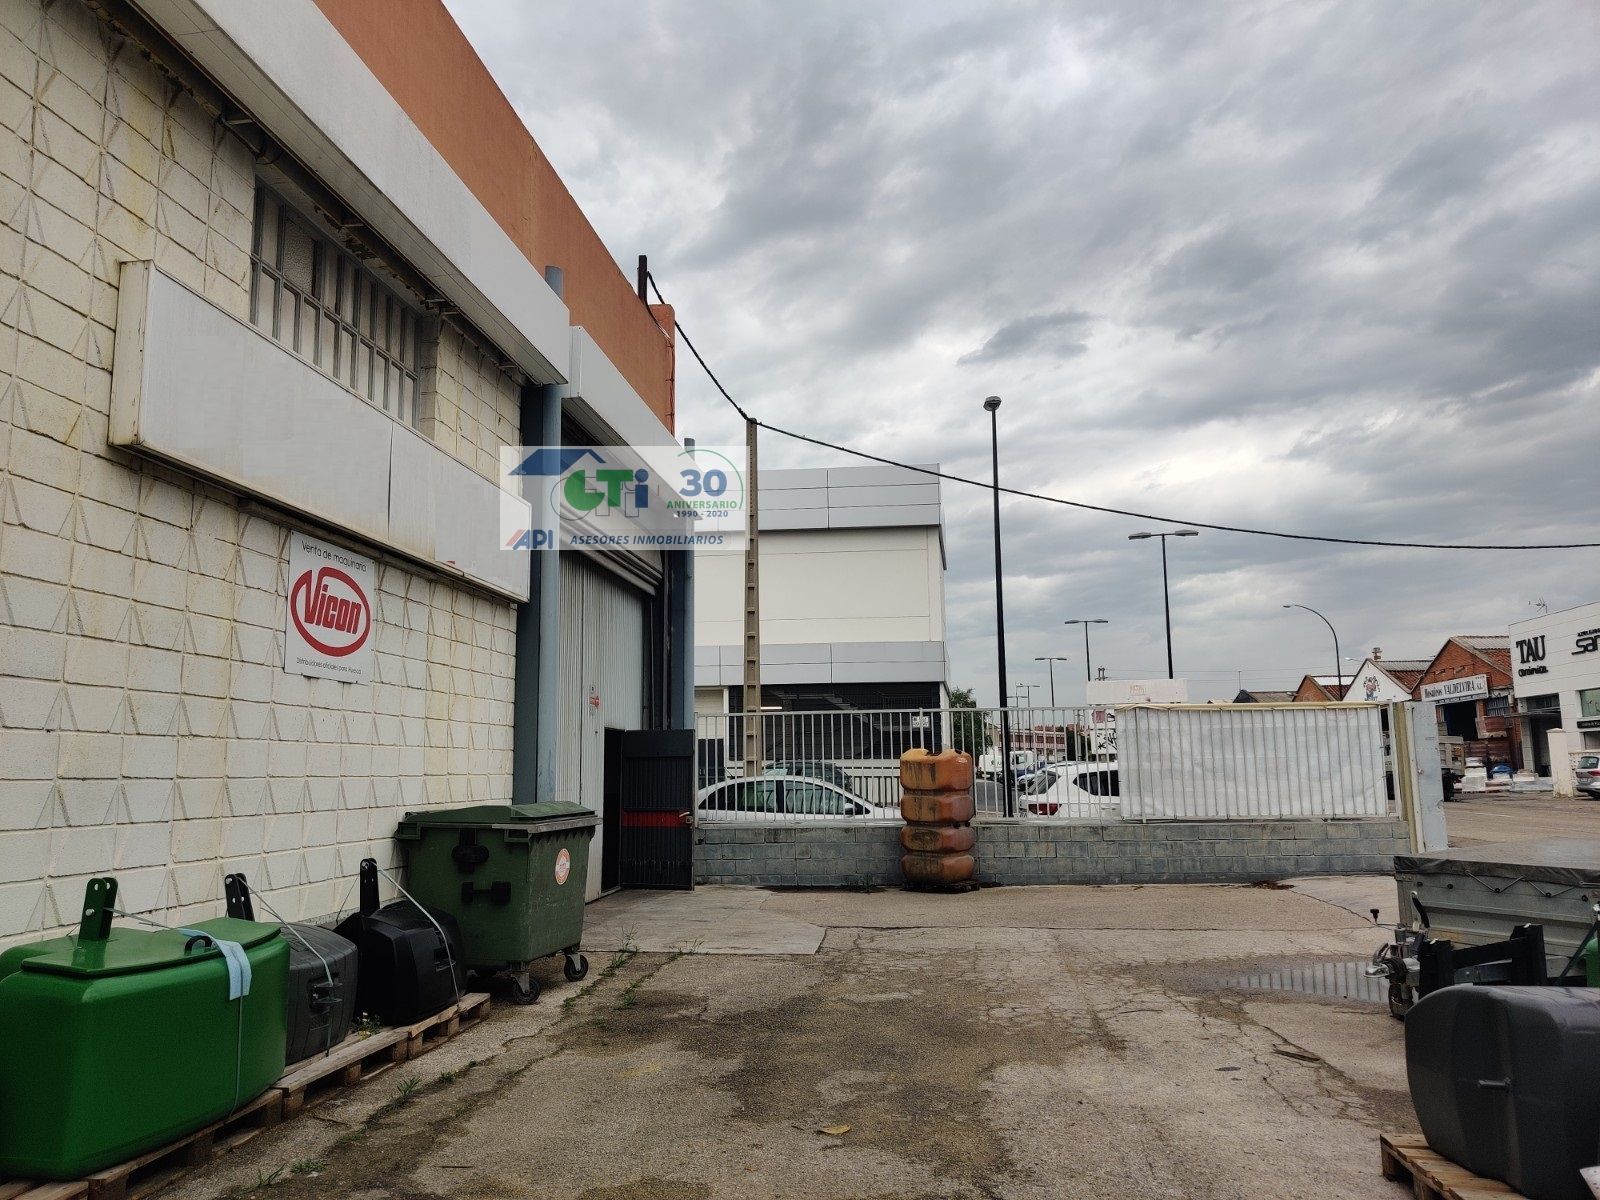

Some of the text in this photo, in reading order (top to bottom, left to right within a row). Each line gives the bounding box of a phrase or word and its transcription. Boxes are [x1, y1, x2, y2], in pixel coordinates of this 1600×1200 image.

[301, 540, 367, 573] Venta de maquinaria
[304, 567, 362, 635] Vicon
[1515, 635, 1546, 664] TAU
